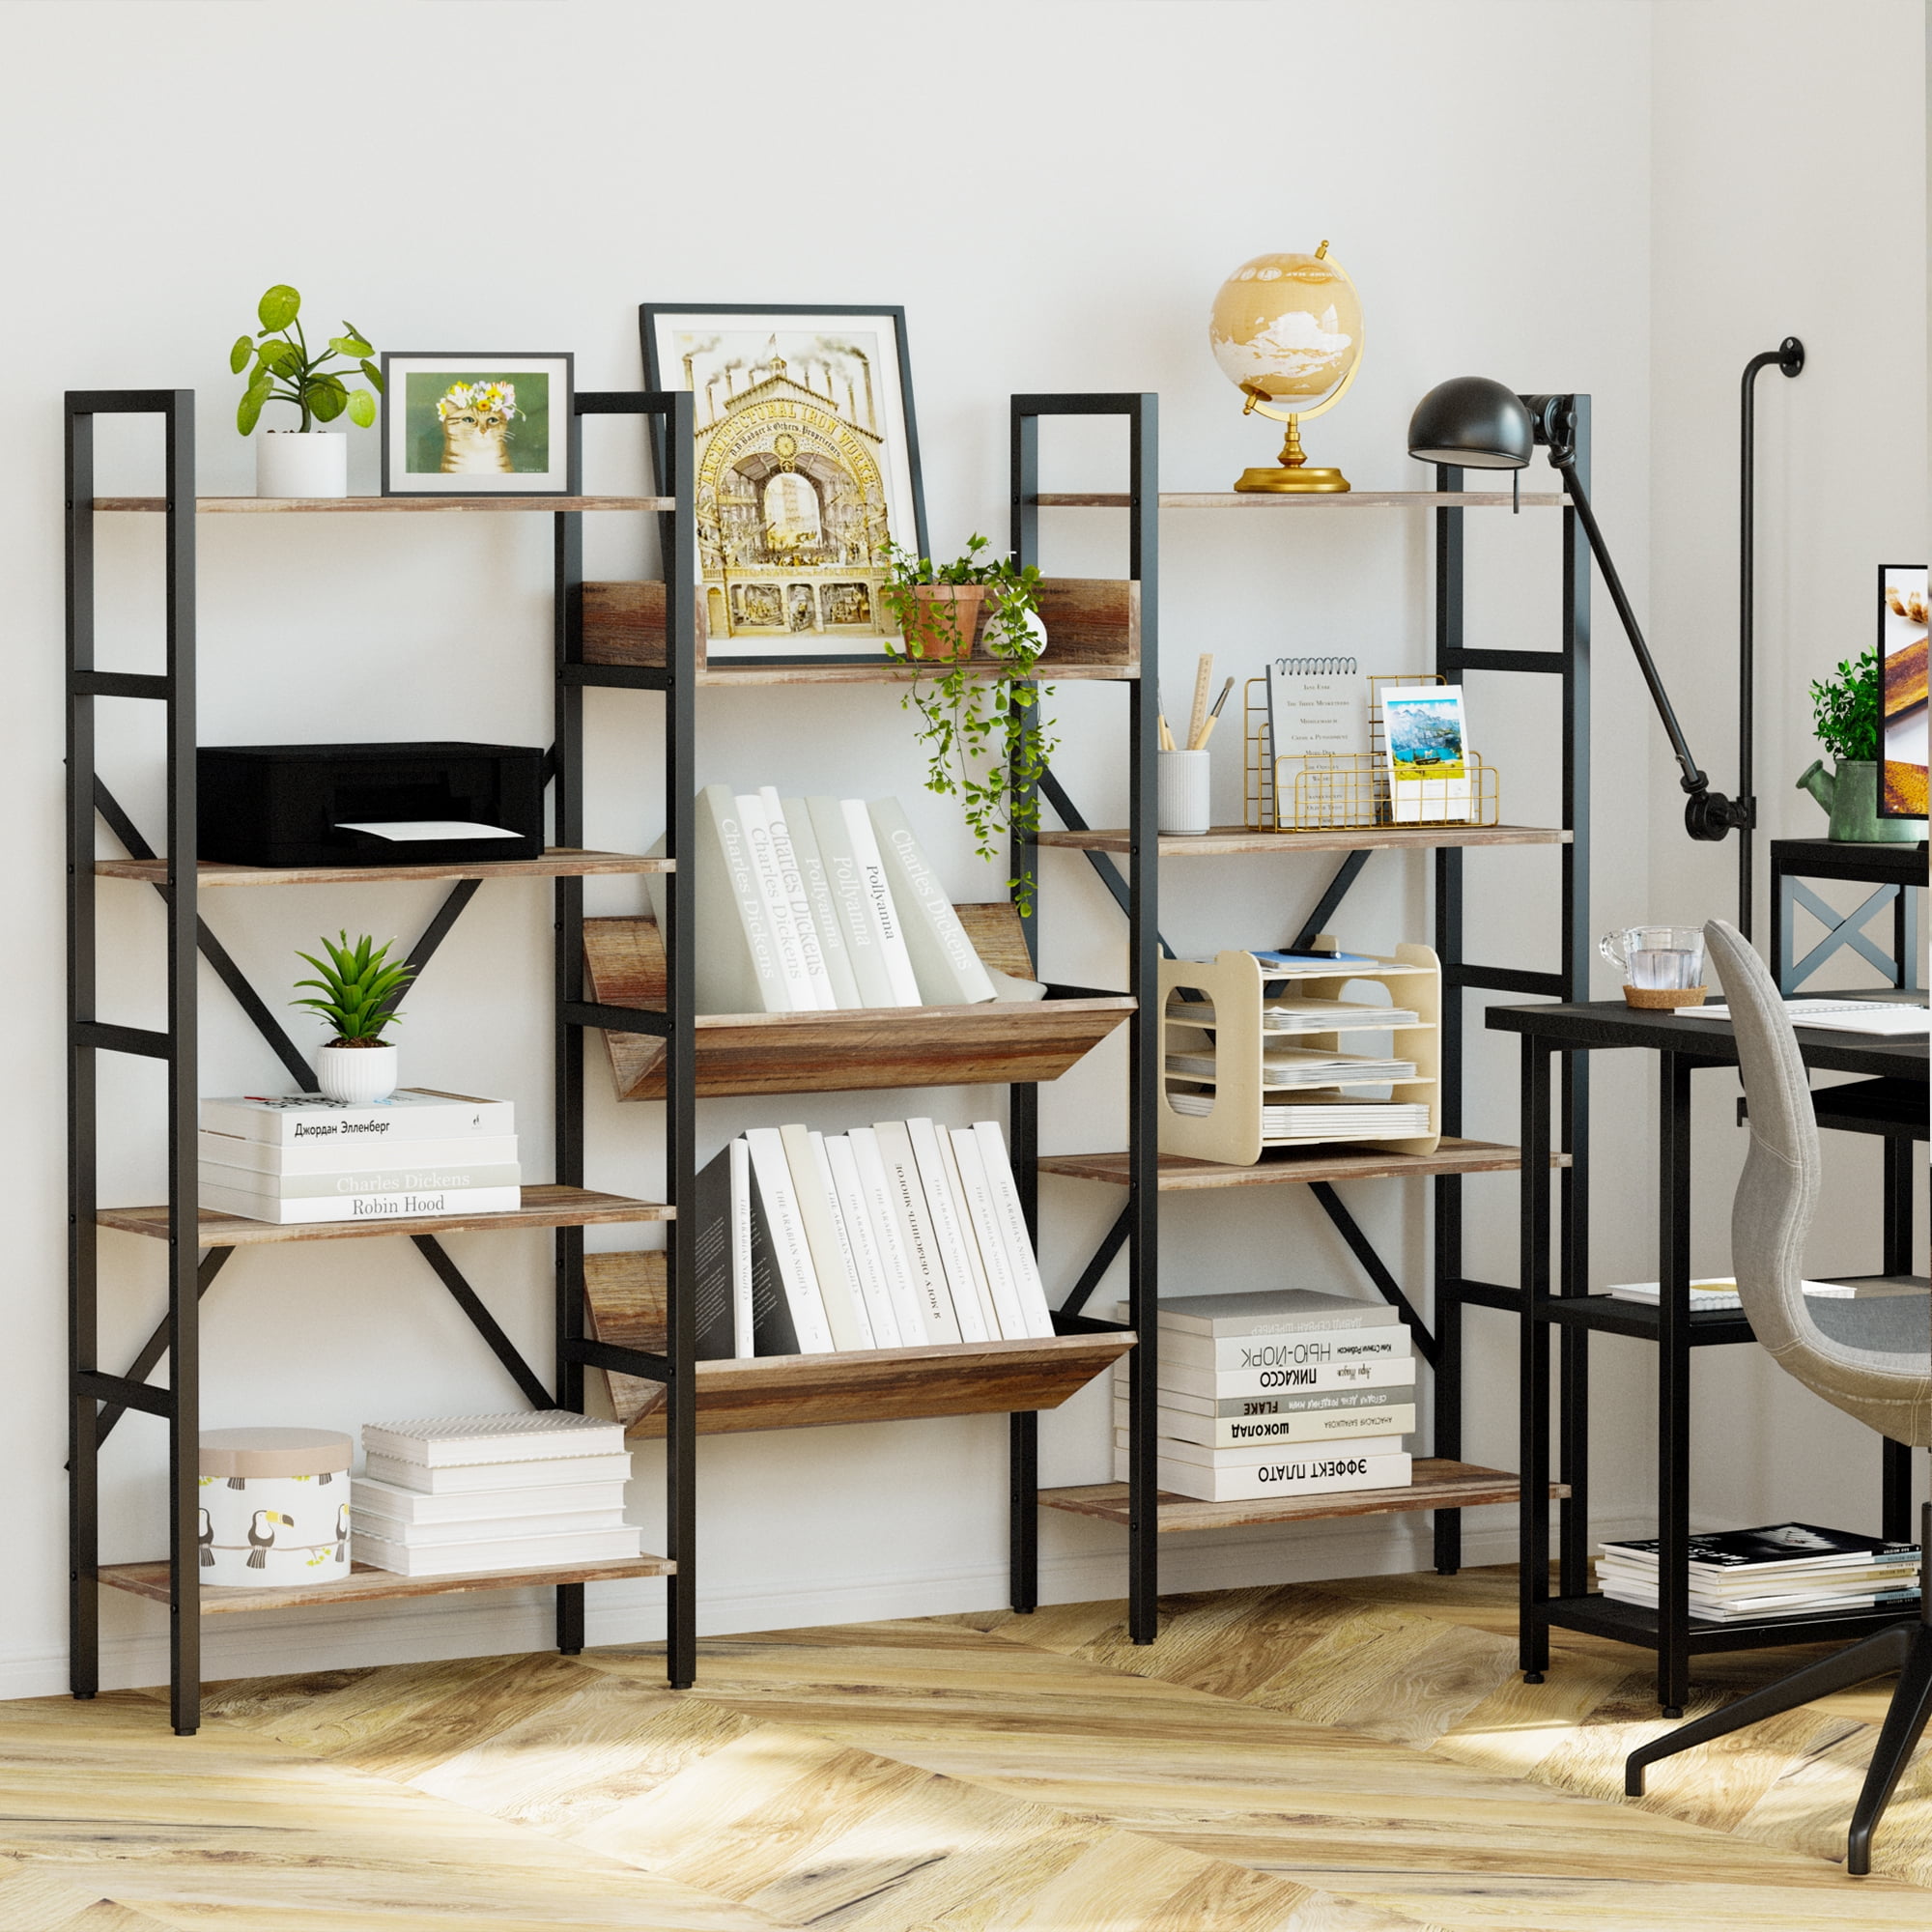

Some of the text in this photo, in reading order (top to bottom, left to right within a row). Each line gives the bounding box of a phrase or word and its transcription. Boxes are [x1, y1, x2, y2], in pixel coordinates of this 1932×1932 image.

[700, 401, 876, 487] ARCHITECTURAL IRON WORKS
[722, 818, 774, 979] Charles Dickens
[752, 828, 802, 980] Charles Dickens
[769, 821, 824, 976] Charles Dickens
[805, 857, 840, 949] Pollyanna
[833, 856, 870, 947] Pollyanna
[867, 866, 895, 940] Pollyanna
[892, 829, 972, 971] Charles Dickens
[295, 1120, 390, 1138] Джордан Элленберг
[336, 1173, 470, 1193] Charles Dickens
[353, 1194, 444, 1215] Robin Hood
[781, 1211, 799, 1256] ARABIAN
[793, 1258, 809, 1296] NIGHTS
[895, 1163, 941, 1320] Я МОГУ ОБЪЯСНИТЬ МНОГОЕ
[1240, 1342, 1331, 1367] НЬЮ-ЙОРК
[1260, 1368, 1317, 1388] ПИКАССО
[1232, 1422, 1290, 1437] ШОКОЛАД
[1244, 1401, 1278, 1415] FLAKE
[1324, 1416, 1393, 1429] АНАСТАСИЯ БАРАШКОВА
[1258, 1459, 1367, 1483] ЭФФЕКТ ПЛАТО
